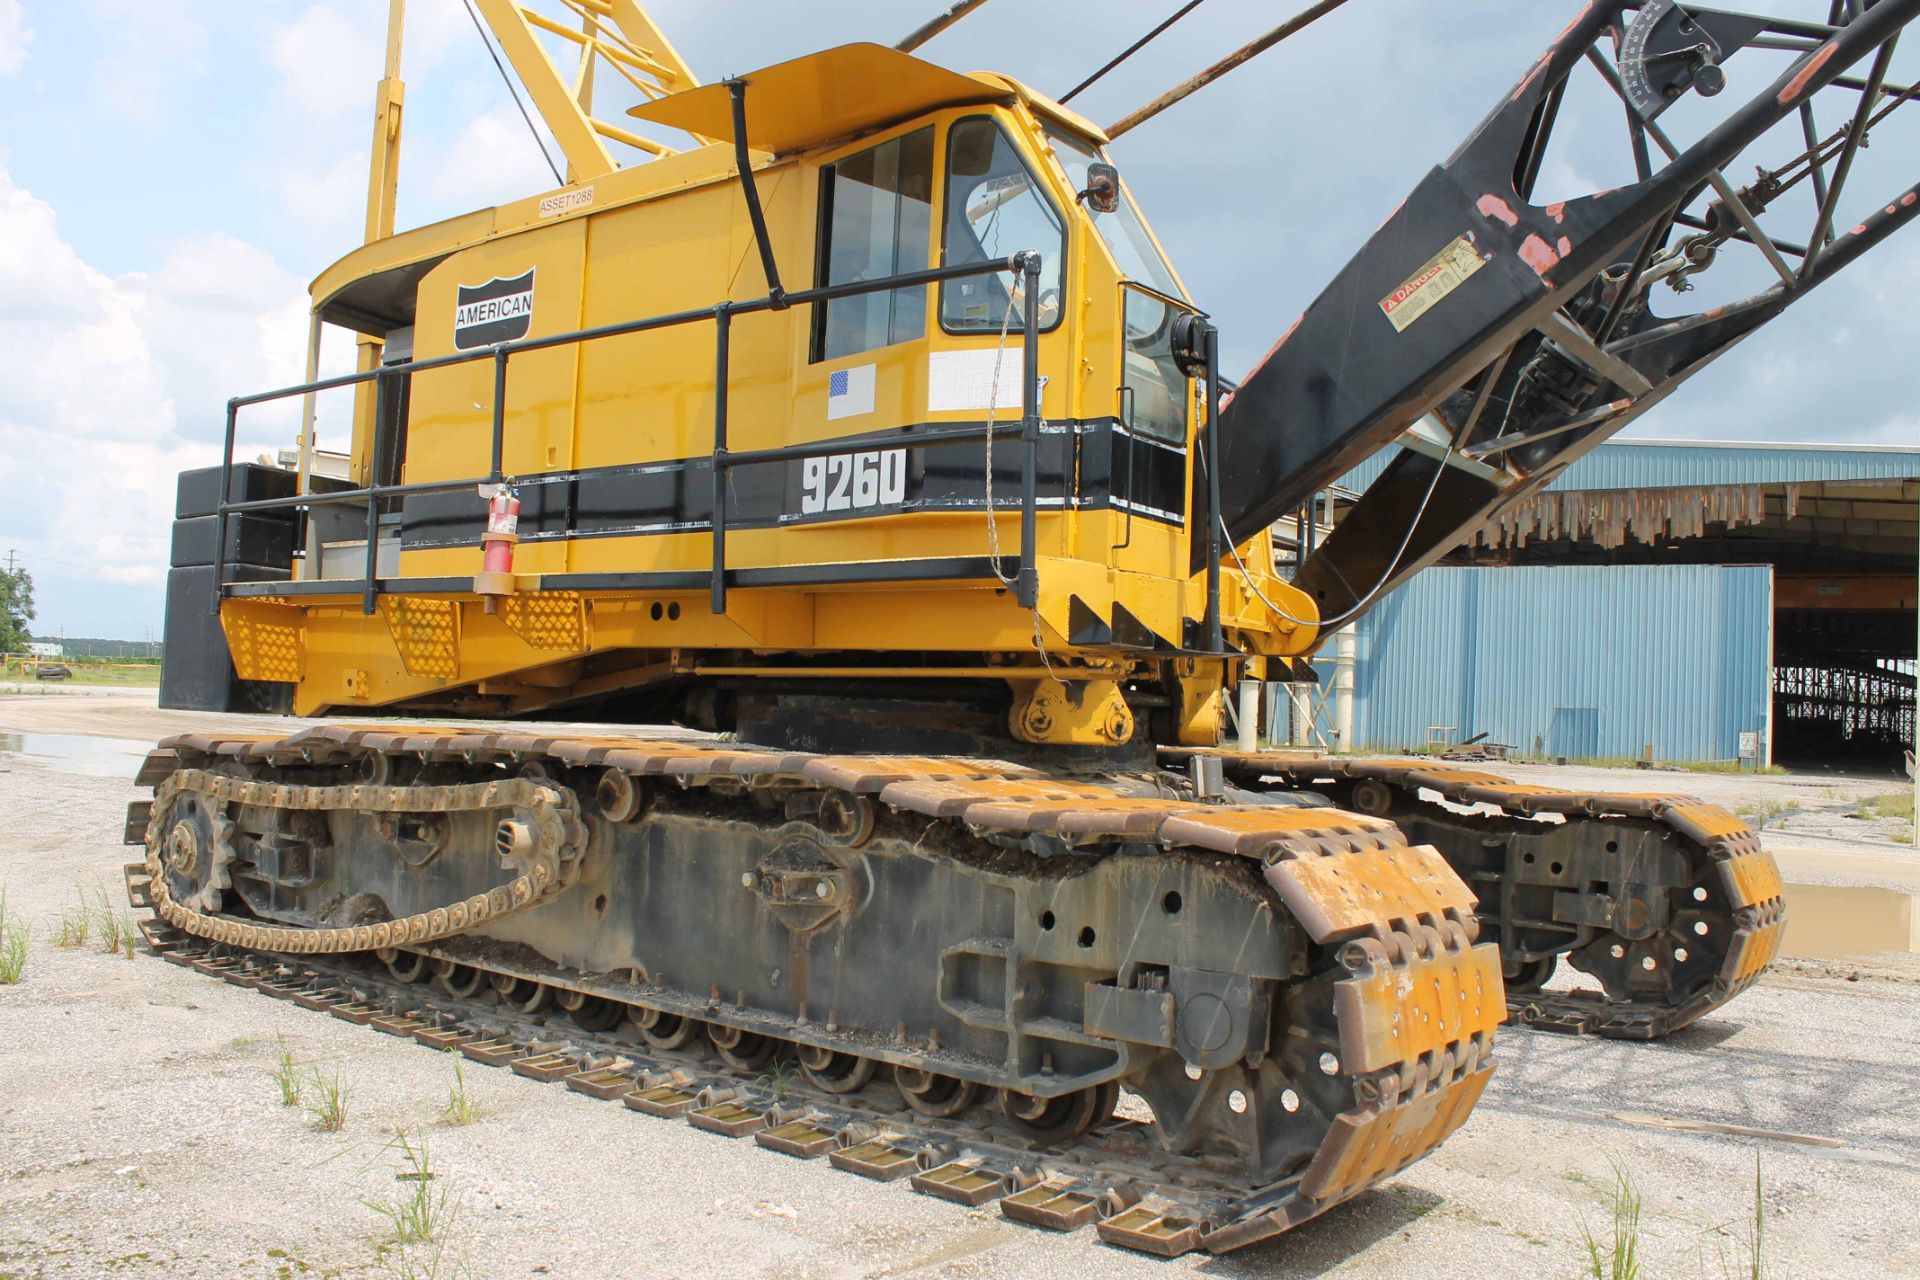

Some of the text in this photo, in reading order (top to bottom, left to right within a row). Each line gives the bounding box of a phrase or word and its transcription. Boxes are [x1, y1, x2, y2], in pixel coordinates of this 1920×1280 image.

[540, 190, 592, 212] ASSET1288
[457, 294, 532, 326] AMERICAN
[802, 448, 906, 514] 9260
